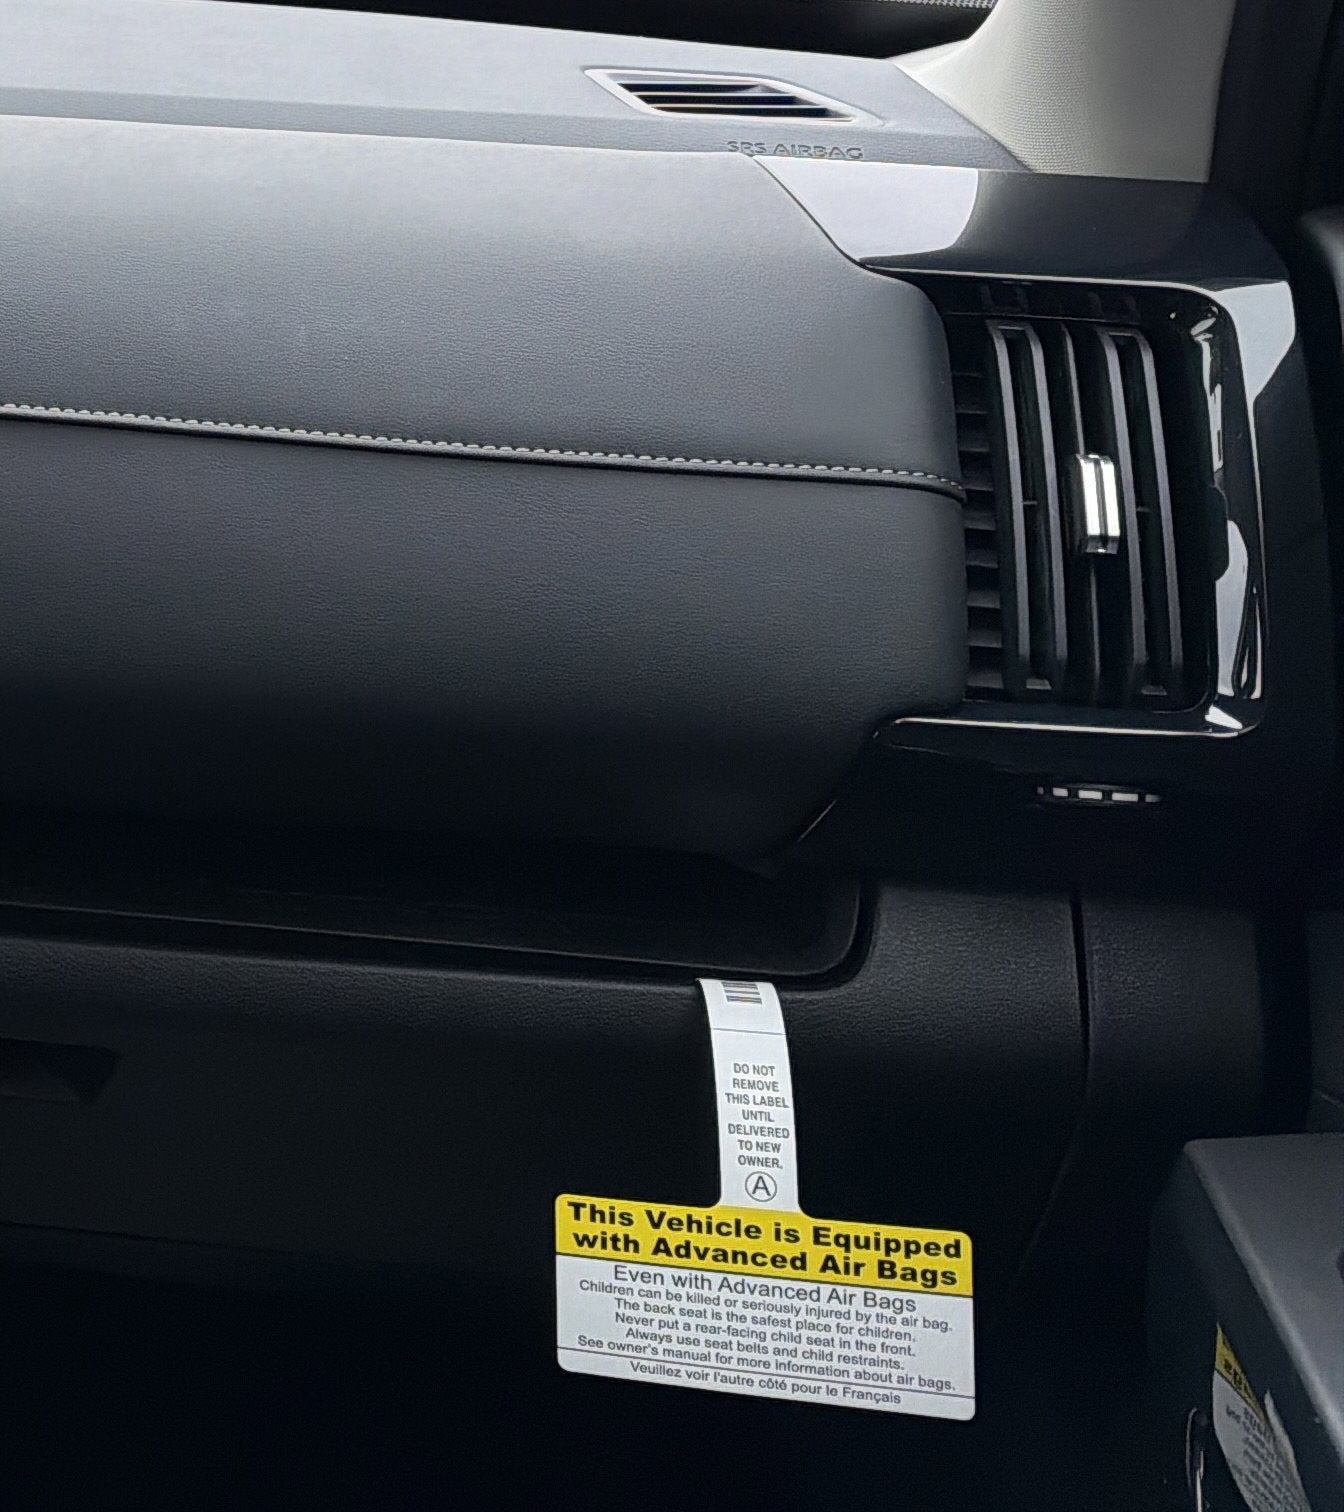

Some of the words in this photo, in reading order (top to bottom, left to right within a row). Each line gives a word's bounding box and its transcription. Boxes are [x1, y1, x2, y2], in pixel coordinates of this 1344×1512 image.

[727, 140, 767, 155] SRS
[772, 143, 864, 160] AIRBAG
[733, 1063, 749, 1074] DO
[752, 1065, 775, 1076] NOT
[733, 1078, 779, 1092] REMOVE
[725, 1093, 750, 1105] THIS
[753, 1096, 789, 1108] LABEL
[742, 1109, 775, 1122] UNTIL
[728, 1123, 790, 1139] DELIVERED
[737, 1140, 753, 1151] TO
[756, 1141, 781, 1153] NEW
[738, 1155, 783, 1169] OWNER.
[568, 1202, 634, 1226] This
[645, 1210, 762, 1239] Vehicle
[774, 1222, 800, 1243] is
[813, 1226, 961, 1259] Equipped
[573, 1232, 640, 1253] with
[652, 1238, 807, 1271] Advanced
[819, 1254, 866, 1277] Air
[878, 1260, 958, 1289] Bags
[579, 1279, 633, 1296] Children
[638, 1289, 662, 1300] can
[666, 1289, 682, 1301] be
[686, 1292, 720, 1306] killed
[724, 1298, 737, 1308] or
[742, 1299, 801, 1315] seriously
[806, 1305, 851, 1321] injured
[856, 1308, 872, 1324] by
[876, 1312, 896, 1325] the
[901, 1314, 918, 1326] air
[923, 1317, 952, 1333] bag.
[614, 1265, 664, 1285] Even
[672, 1274, 711, 1291] with
[718, 1277, 821, 1302] Advanced
[827, 1288, 856, 1306] Air
[864, 1291, 917, 1314] Bags
[615, 1298, 640, 1311] The
[644, 1302, 675, 1315] back
[679, 1307, 707, 1319] seat
[712, 1309, 722, 1320] is
[726, 1311, 747, 1324] the
[751, 1314, 791, 1329] safest
[795, 1319, 831, 1334] place
[836, 1323, 854, 1335] for
[858, 1326, 915, 1342] children.
[616, 1312, 655, 1326] Never
[658, 1317, 679, 1332] put
[683, 1322, 691, 1331] a
[695, 1323, 766, 1342] rear-facing
[771, 1330, 801, 1344] child
[806, 1335, 835, 1348] seat
[839, 1338, 851, 1349] in
[855, 1339, 876, 1351] the
[881, 1343, 915, 1357] front.
[578, 1335, 603, 1348] See
[608, 1342, 658, 1355] owner's
[662, 1347, 711, 1361] manual
[715, 1352, 733, 1364] for
[737, 1358, 771, 1369] more
[775, 1359, 850, 1378] information
[854, 1369, 892, 1384] about
[897, 1373, 914, 1385] air
[918, 1375, 955, 1391] bags.
[626, 1328, 672, 1344] Always
[676, 1335, 700, 1346] use
[705, 1337, 732, 1350] seat
[737, 1340, 768, 1354] belts
[773, 1346, 797, 1358] and
[802, 1348, 833, 1362] child
[837, 1352, 904, 1370] restraints.
[630, 1361, 681, 1378] Veuillez
[685, 1368, 710, 1381] voir
[714, 1372, 754, 1387] l'autre
[759, 1377, 787, 1390] côté
[791, 1383, 822, 1395] pour
[826, 1385, 838, 1396] le
[843, 1387, 901, 1404] Français
